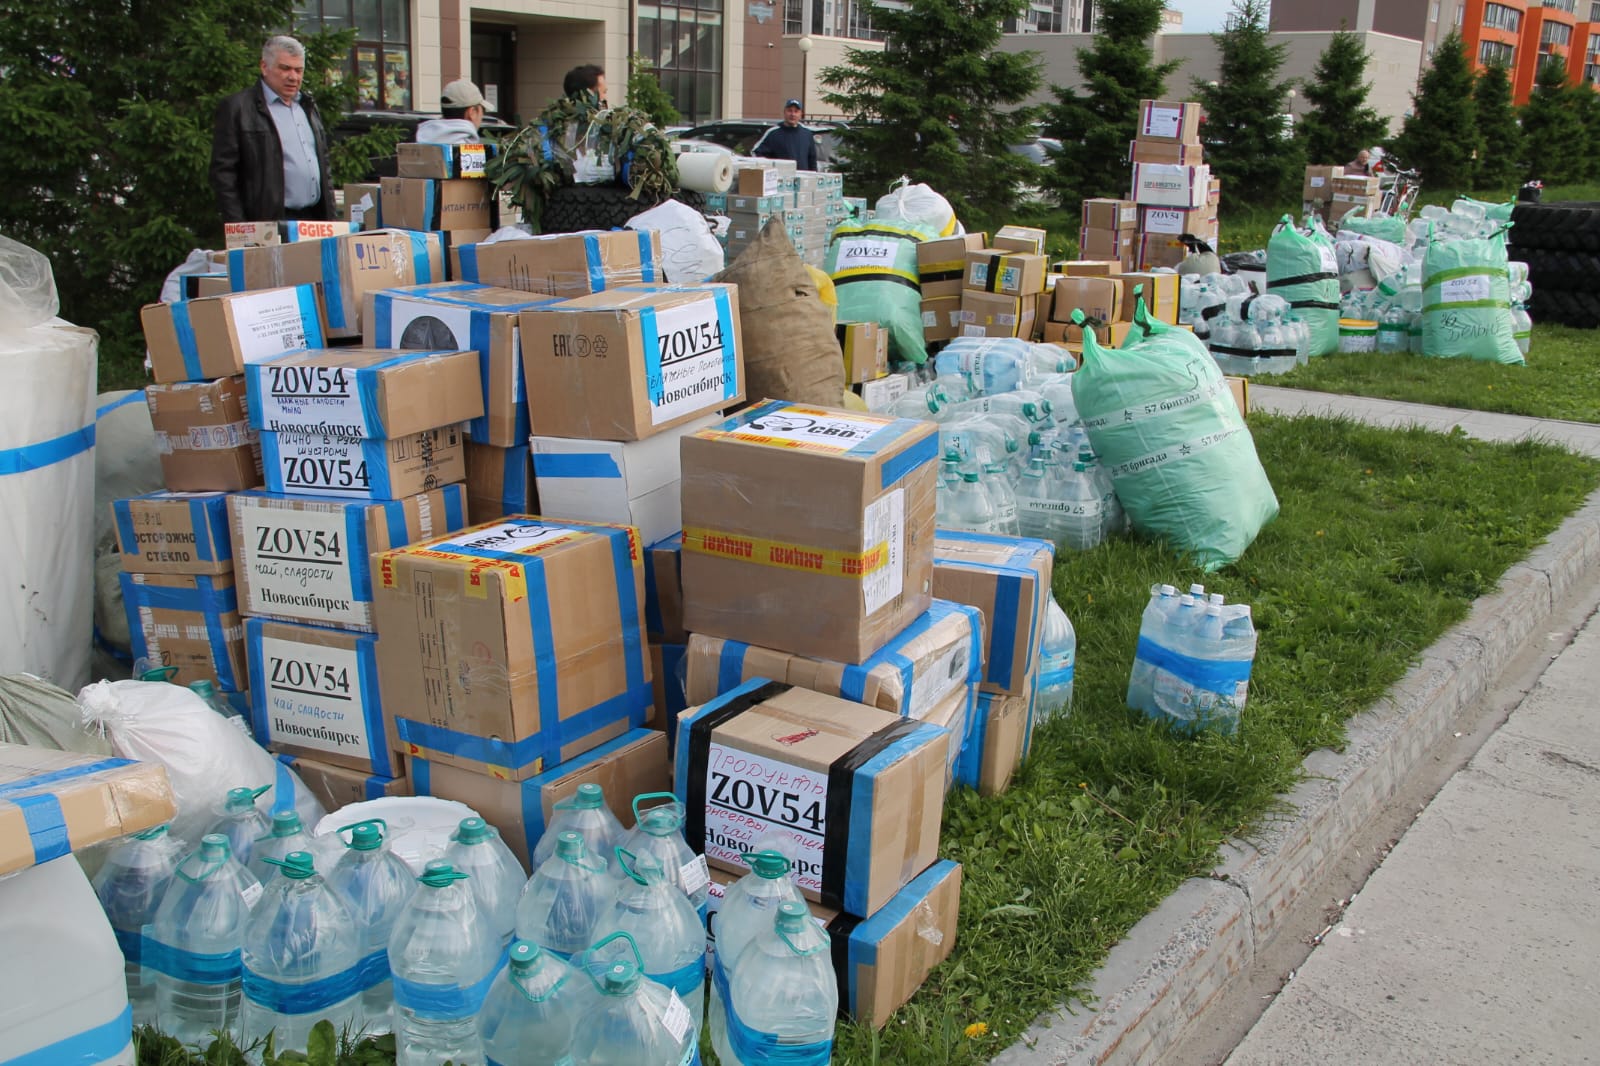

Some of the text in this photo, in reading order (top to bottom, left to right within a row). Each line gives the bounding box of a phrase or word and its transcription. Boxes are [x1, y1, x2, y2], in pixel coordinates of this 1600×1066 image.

[298, 222, 334, 237] GGIES
[658, 319, 724, 363] ZOV54
[269, 366, 349, 393] ZOV54
[656, 372, 732, 407] Новосибирск
[283, 457, 372, 487] ZOV54
[146, 551, 190, 562] СТЕКЛО
[256, 526, 341, 558] ZOV54
[261, 587, 350, 612] Новосибирск
[270, 657, 350, 693] ZOV54
[275, 718, 360, 745] Новосибирск
[711, 771, 824, 831] ZOV54
